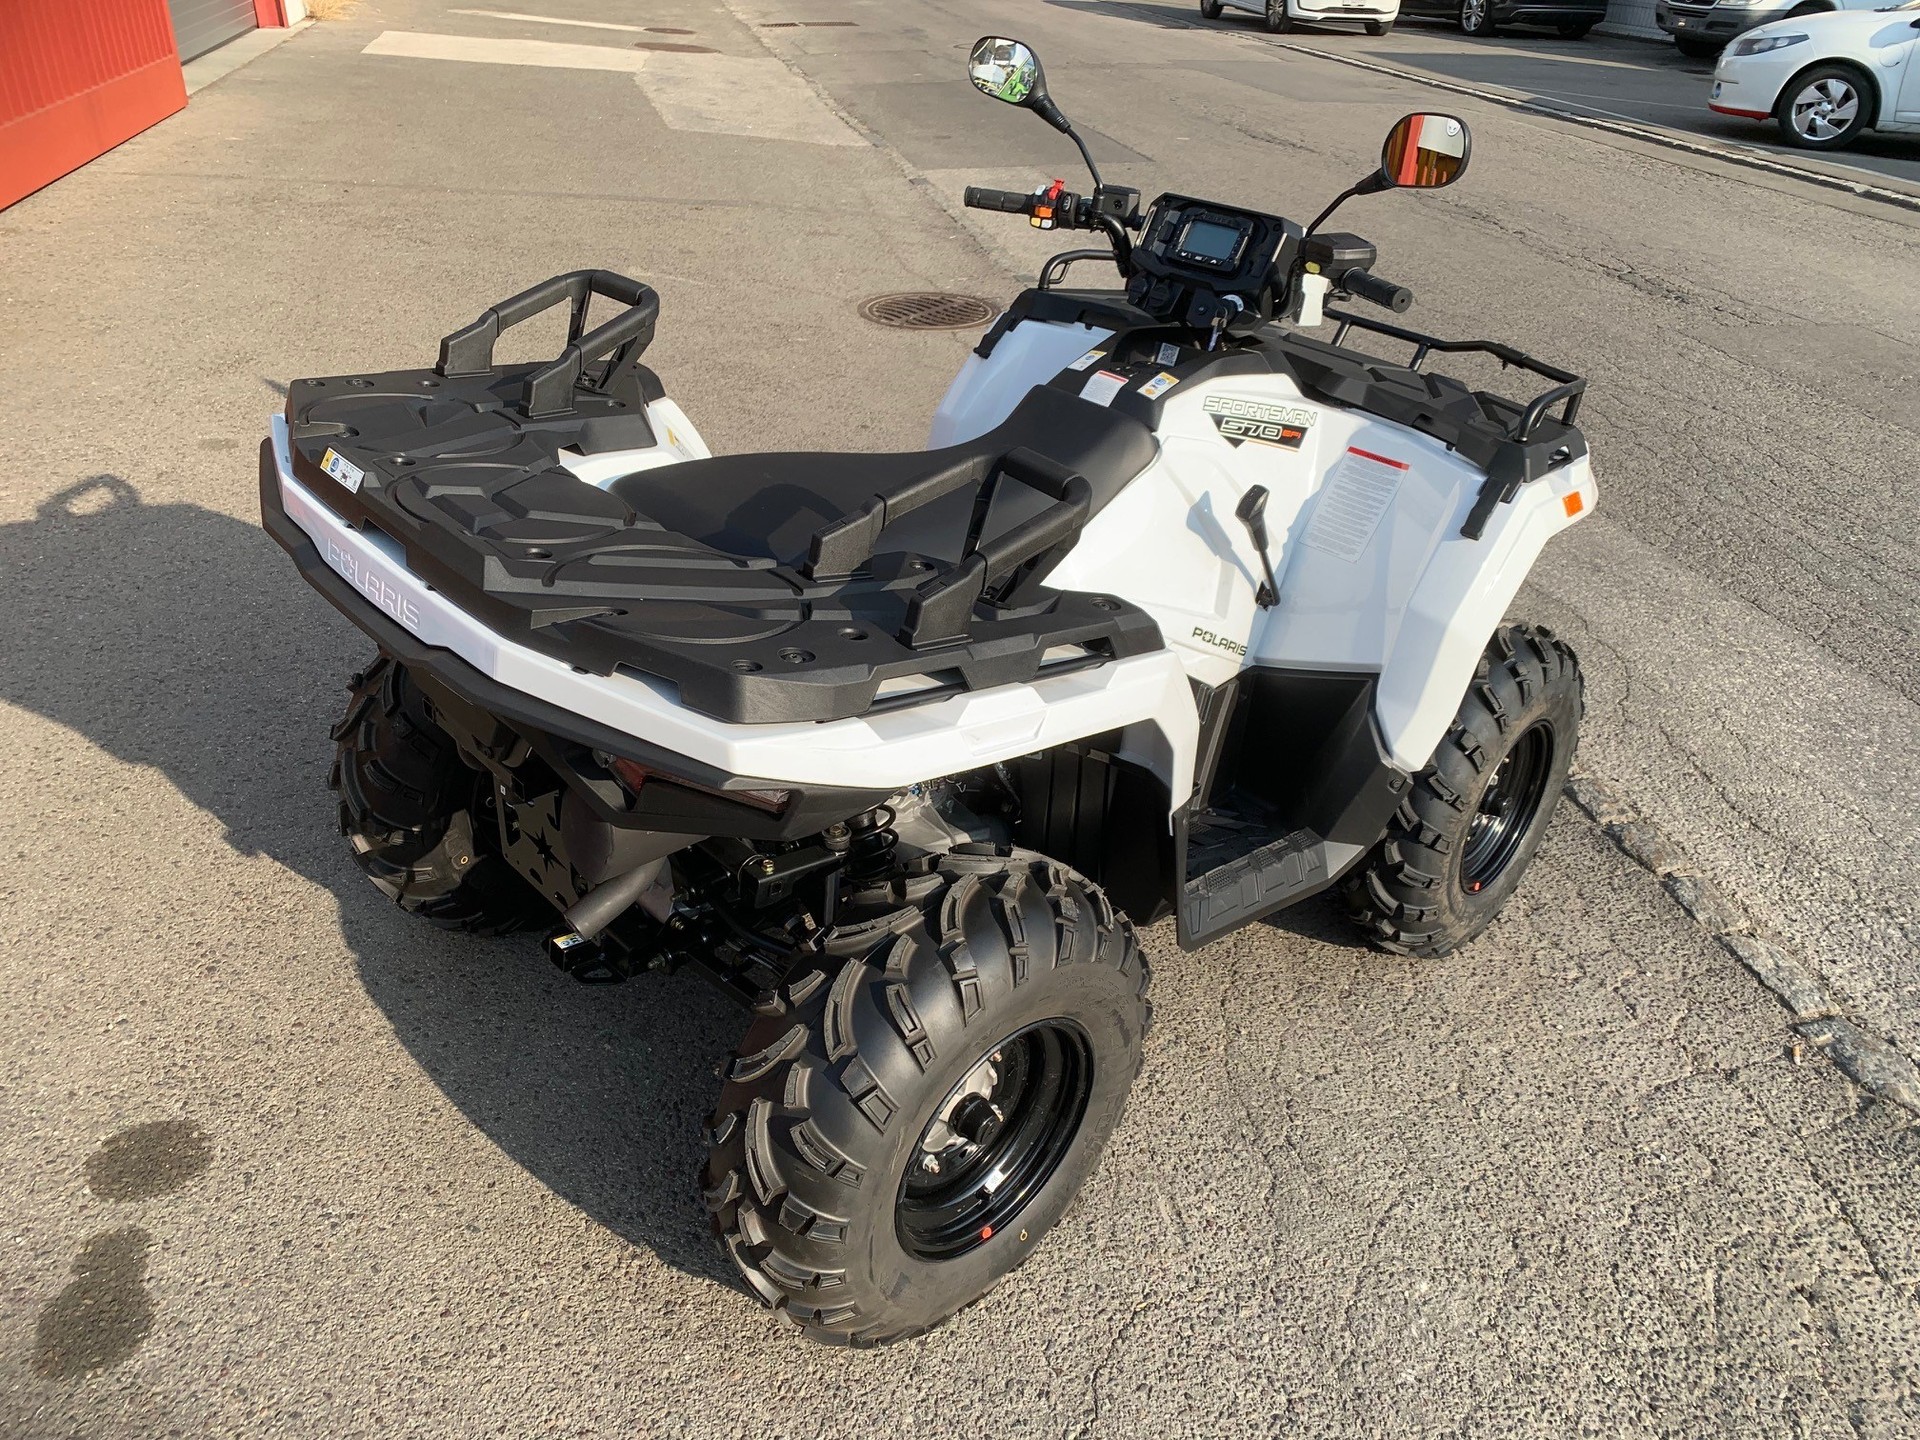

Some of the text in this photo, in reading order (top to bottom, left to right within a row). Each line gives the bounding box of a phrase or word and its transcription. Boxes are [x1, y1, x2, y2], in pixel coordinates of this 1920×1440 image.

[1202, 395, 1318, 427] SPORTSMAN
[1219, 417, 1283, 441] 570
[327, 537, 420, 630] POLARIS
[1191, 626, 1249, 657] POLARIS
